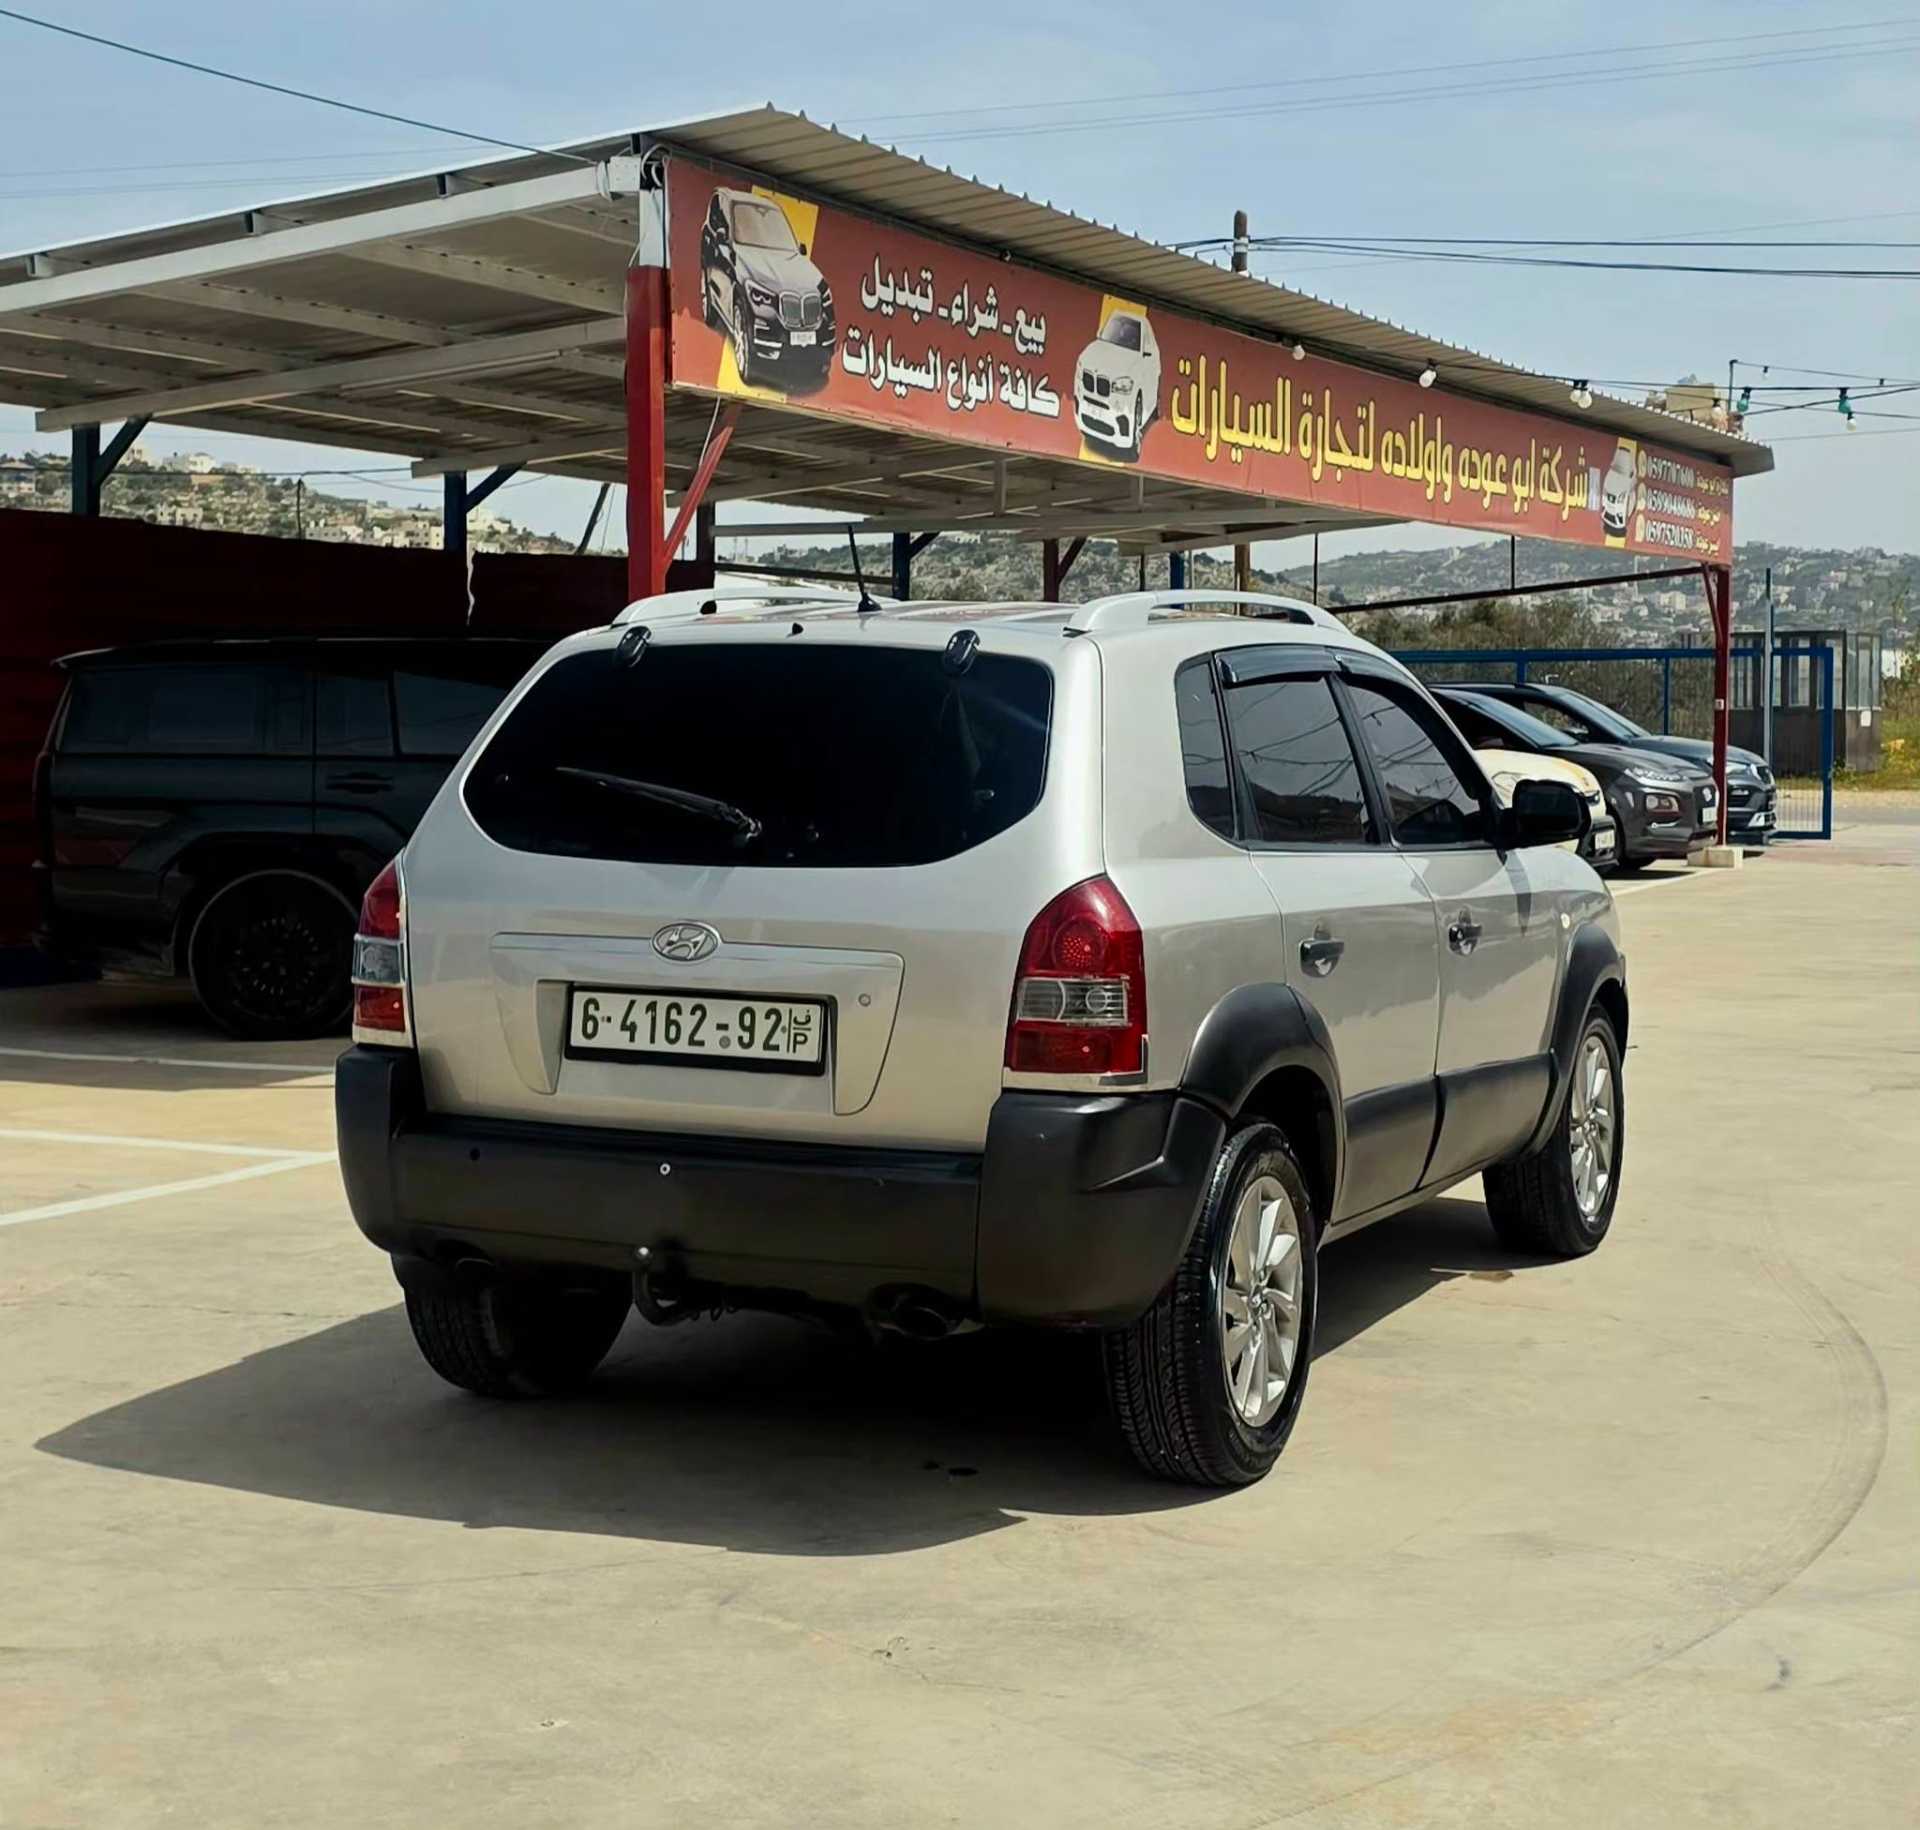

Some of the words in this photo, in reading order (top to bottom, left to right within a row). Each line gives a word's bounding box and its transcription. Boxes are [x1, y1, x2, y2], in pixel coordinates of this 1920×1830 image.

[861, 253, 934, 324] تبديل
[950, 281, 1000, 337] شراء
[841, 324, 943, 399] السيارات
[1014, 307, 1046, 355] بيع
[945, 353, 995, 411] أنواع
[999, 360, 1061, 419] كافة
[1170, 354, 1292, 463] السيارات
[1298, 386, 1376, 484] لتجارة
[1380, 411, 1453, 504] واولاده
[1457, 446, 1508, 510] عوده
[1510, 437, 1536, 514] ابو
[1538, 444, 1590, 523] شركة
[791, 1032, 809, 1054] P
